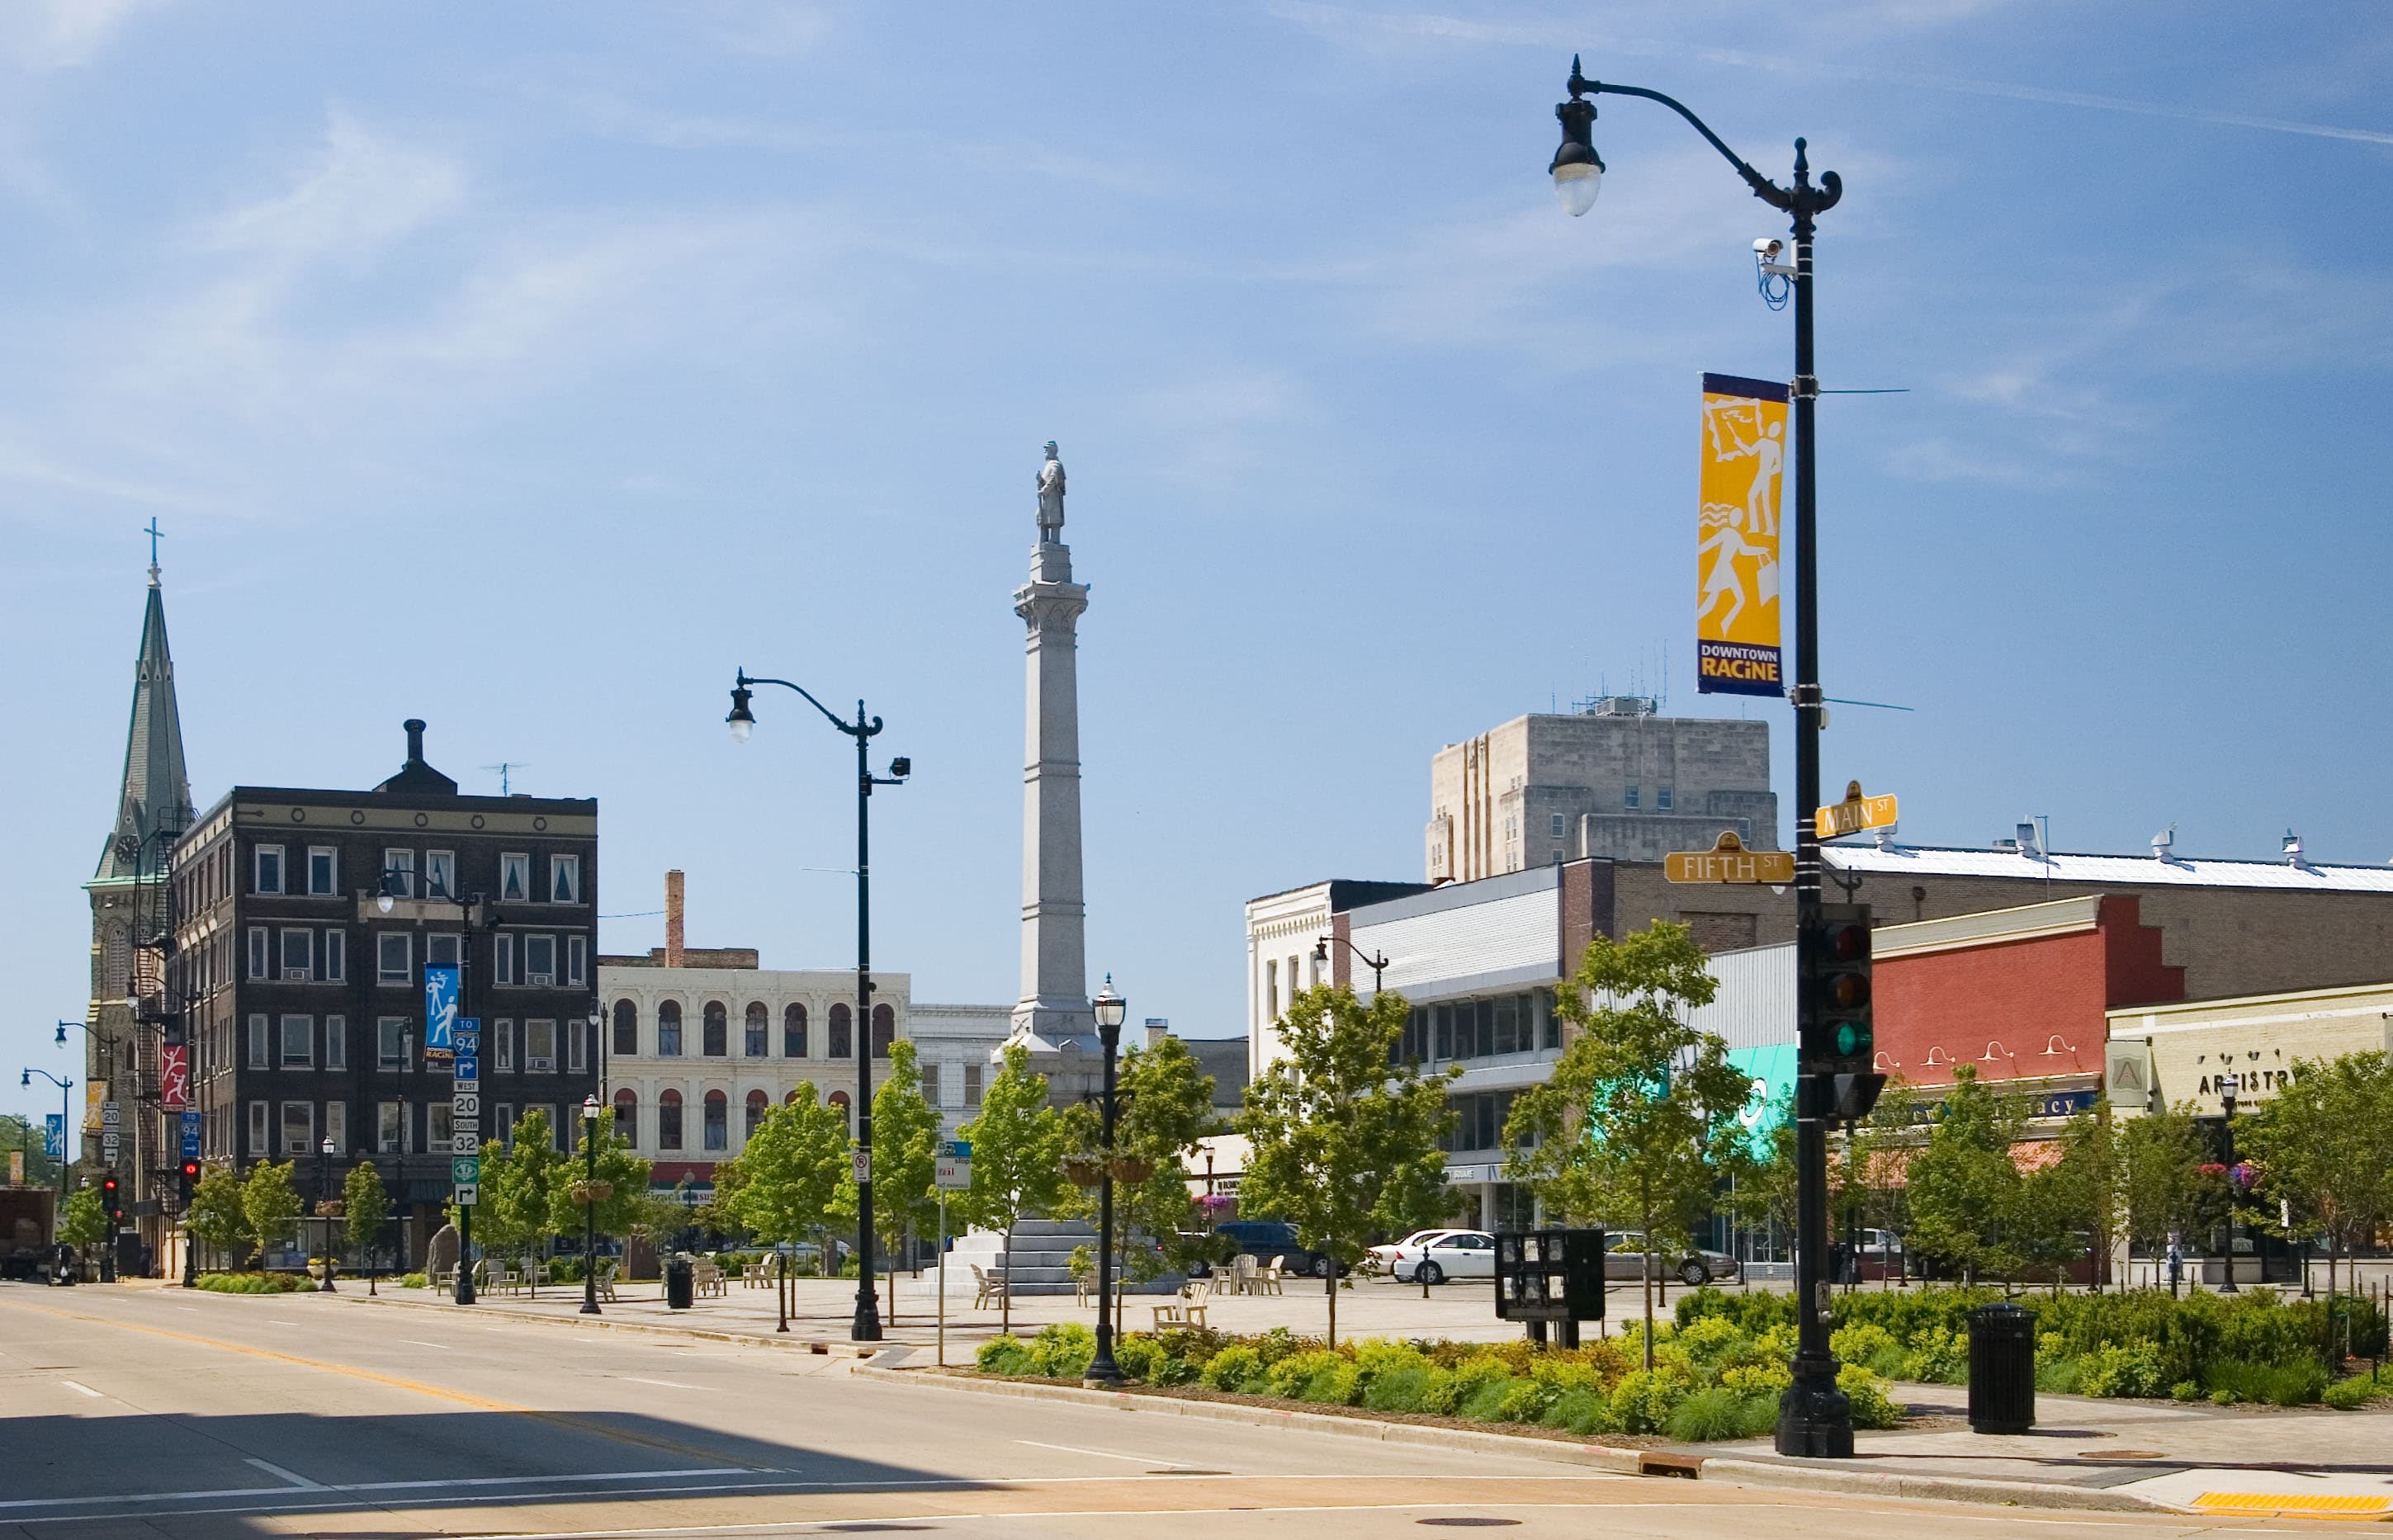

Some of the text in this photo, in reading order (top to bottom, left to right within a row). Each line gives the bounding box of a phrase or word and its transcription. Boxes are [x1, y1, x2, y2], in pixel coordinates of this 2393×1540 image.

[1701, 645, 1777, 662] DOWNTOWN
[1824, 798, 1889, 833] MAIN ST
[1684, 855, 1780, 879] FIFTH ST
[460, 1020, 473, 1029] TO
[456, 1037, 476, 1052] 94
[456, 1082, 475, 1090] WEST
[455, 1098, 476, 1112] 20
[105, 1112, 117, 1121] 20
[183, 1125, 199, 1136] 94
[455, 1120, 478, 1130] SOUTH
[105, 1135, 117, 1145] 32
[456, 1136, 476, 1151] 32
